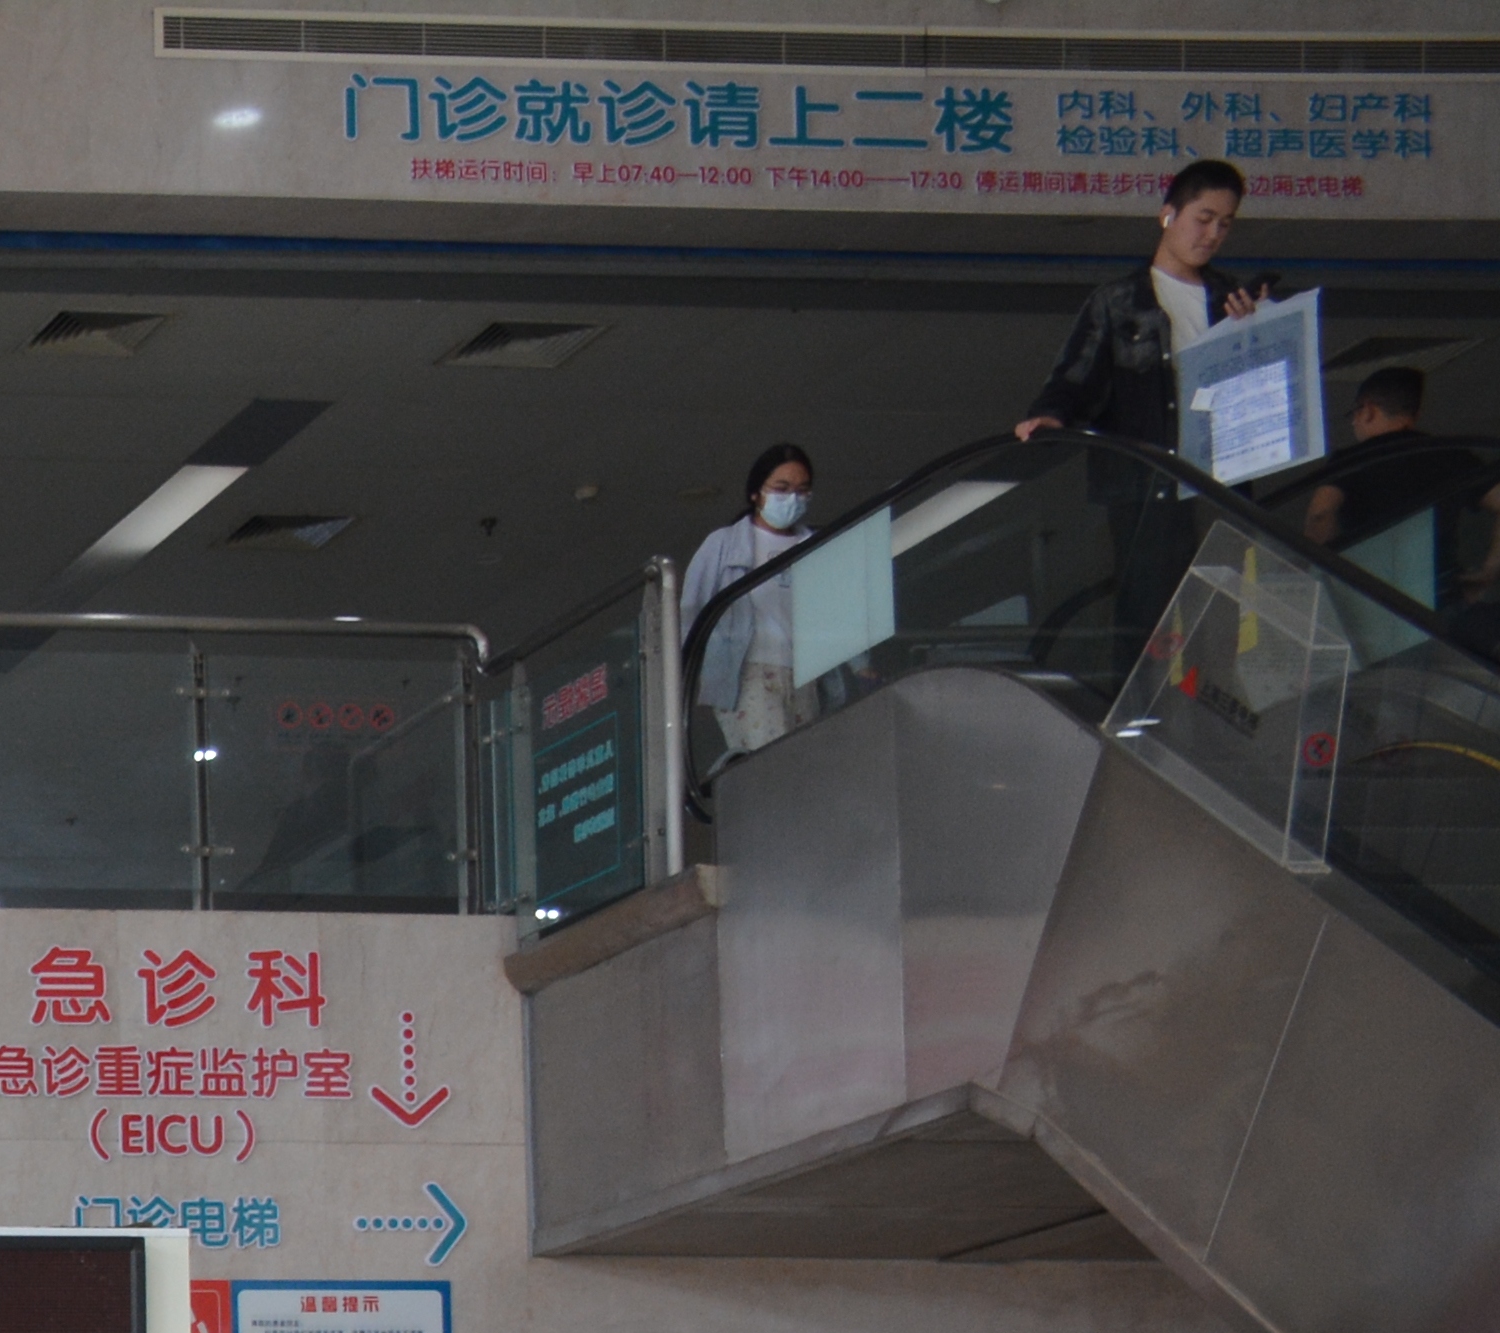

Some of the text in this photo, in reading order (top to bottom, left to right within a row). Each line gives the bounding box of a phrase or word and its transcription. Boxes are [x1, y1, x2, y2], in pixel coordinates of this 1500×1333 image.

[343, 72, 1014, 154] 门诊就诊请上二楼
[1056, 90, 1434, 124] 内科、外科、妇产科
[1056, 125, 1434, 160] 检验科、超声医学科
[30, 945, 326, 1028] 急诊科
[74, 1196, 280, 1248] 门诊电梯
